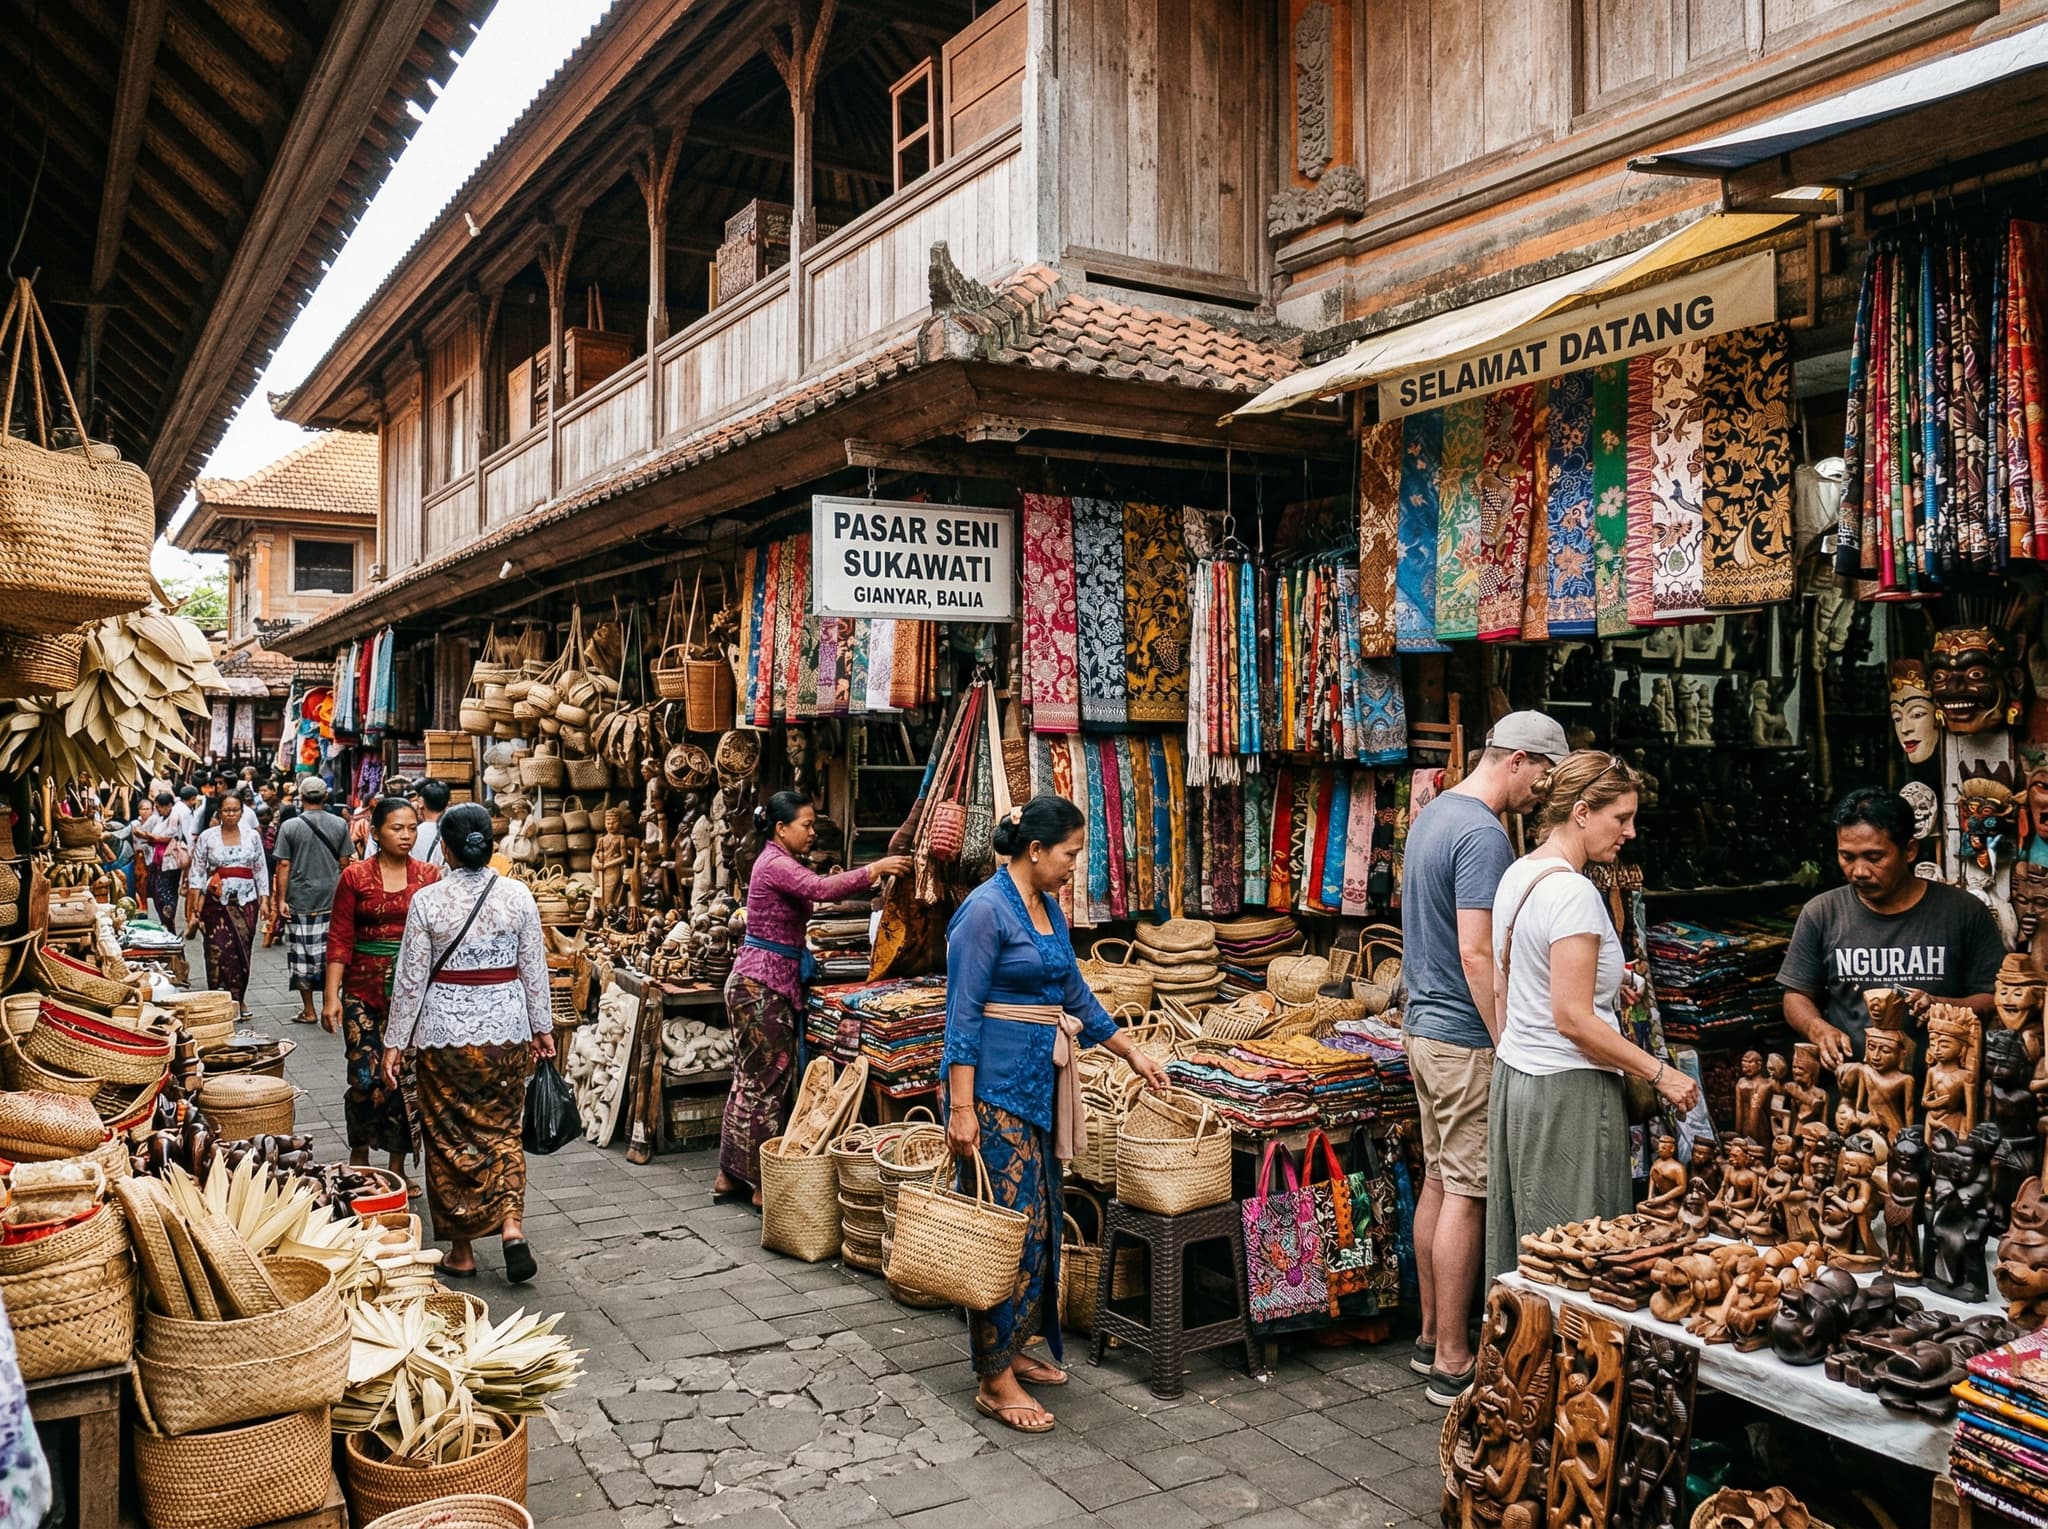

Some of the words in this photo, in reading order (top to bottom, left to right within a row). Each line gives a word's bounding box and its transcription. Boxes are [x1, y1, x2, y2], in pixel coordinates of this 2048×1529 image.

[1399, 340, 1547, 408] SELAMAT
[1559, 295, 1714, 365] DATANG
[833, 511, 927, 545] PASAR
[936, 519, 999, 548] SENI
[843, 549, 991, 583] SUKAWATI
[854, 586, 932, 609] GIANYAR,
[937, 590, 984, 608] BALIA
[1835, 945, 1946, 976] NGURAH
